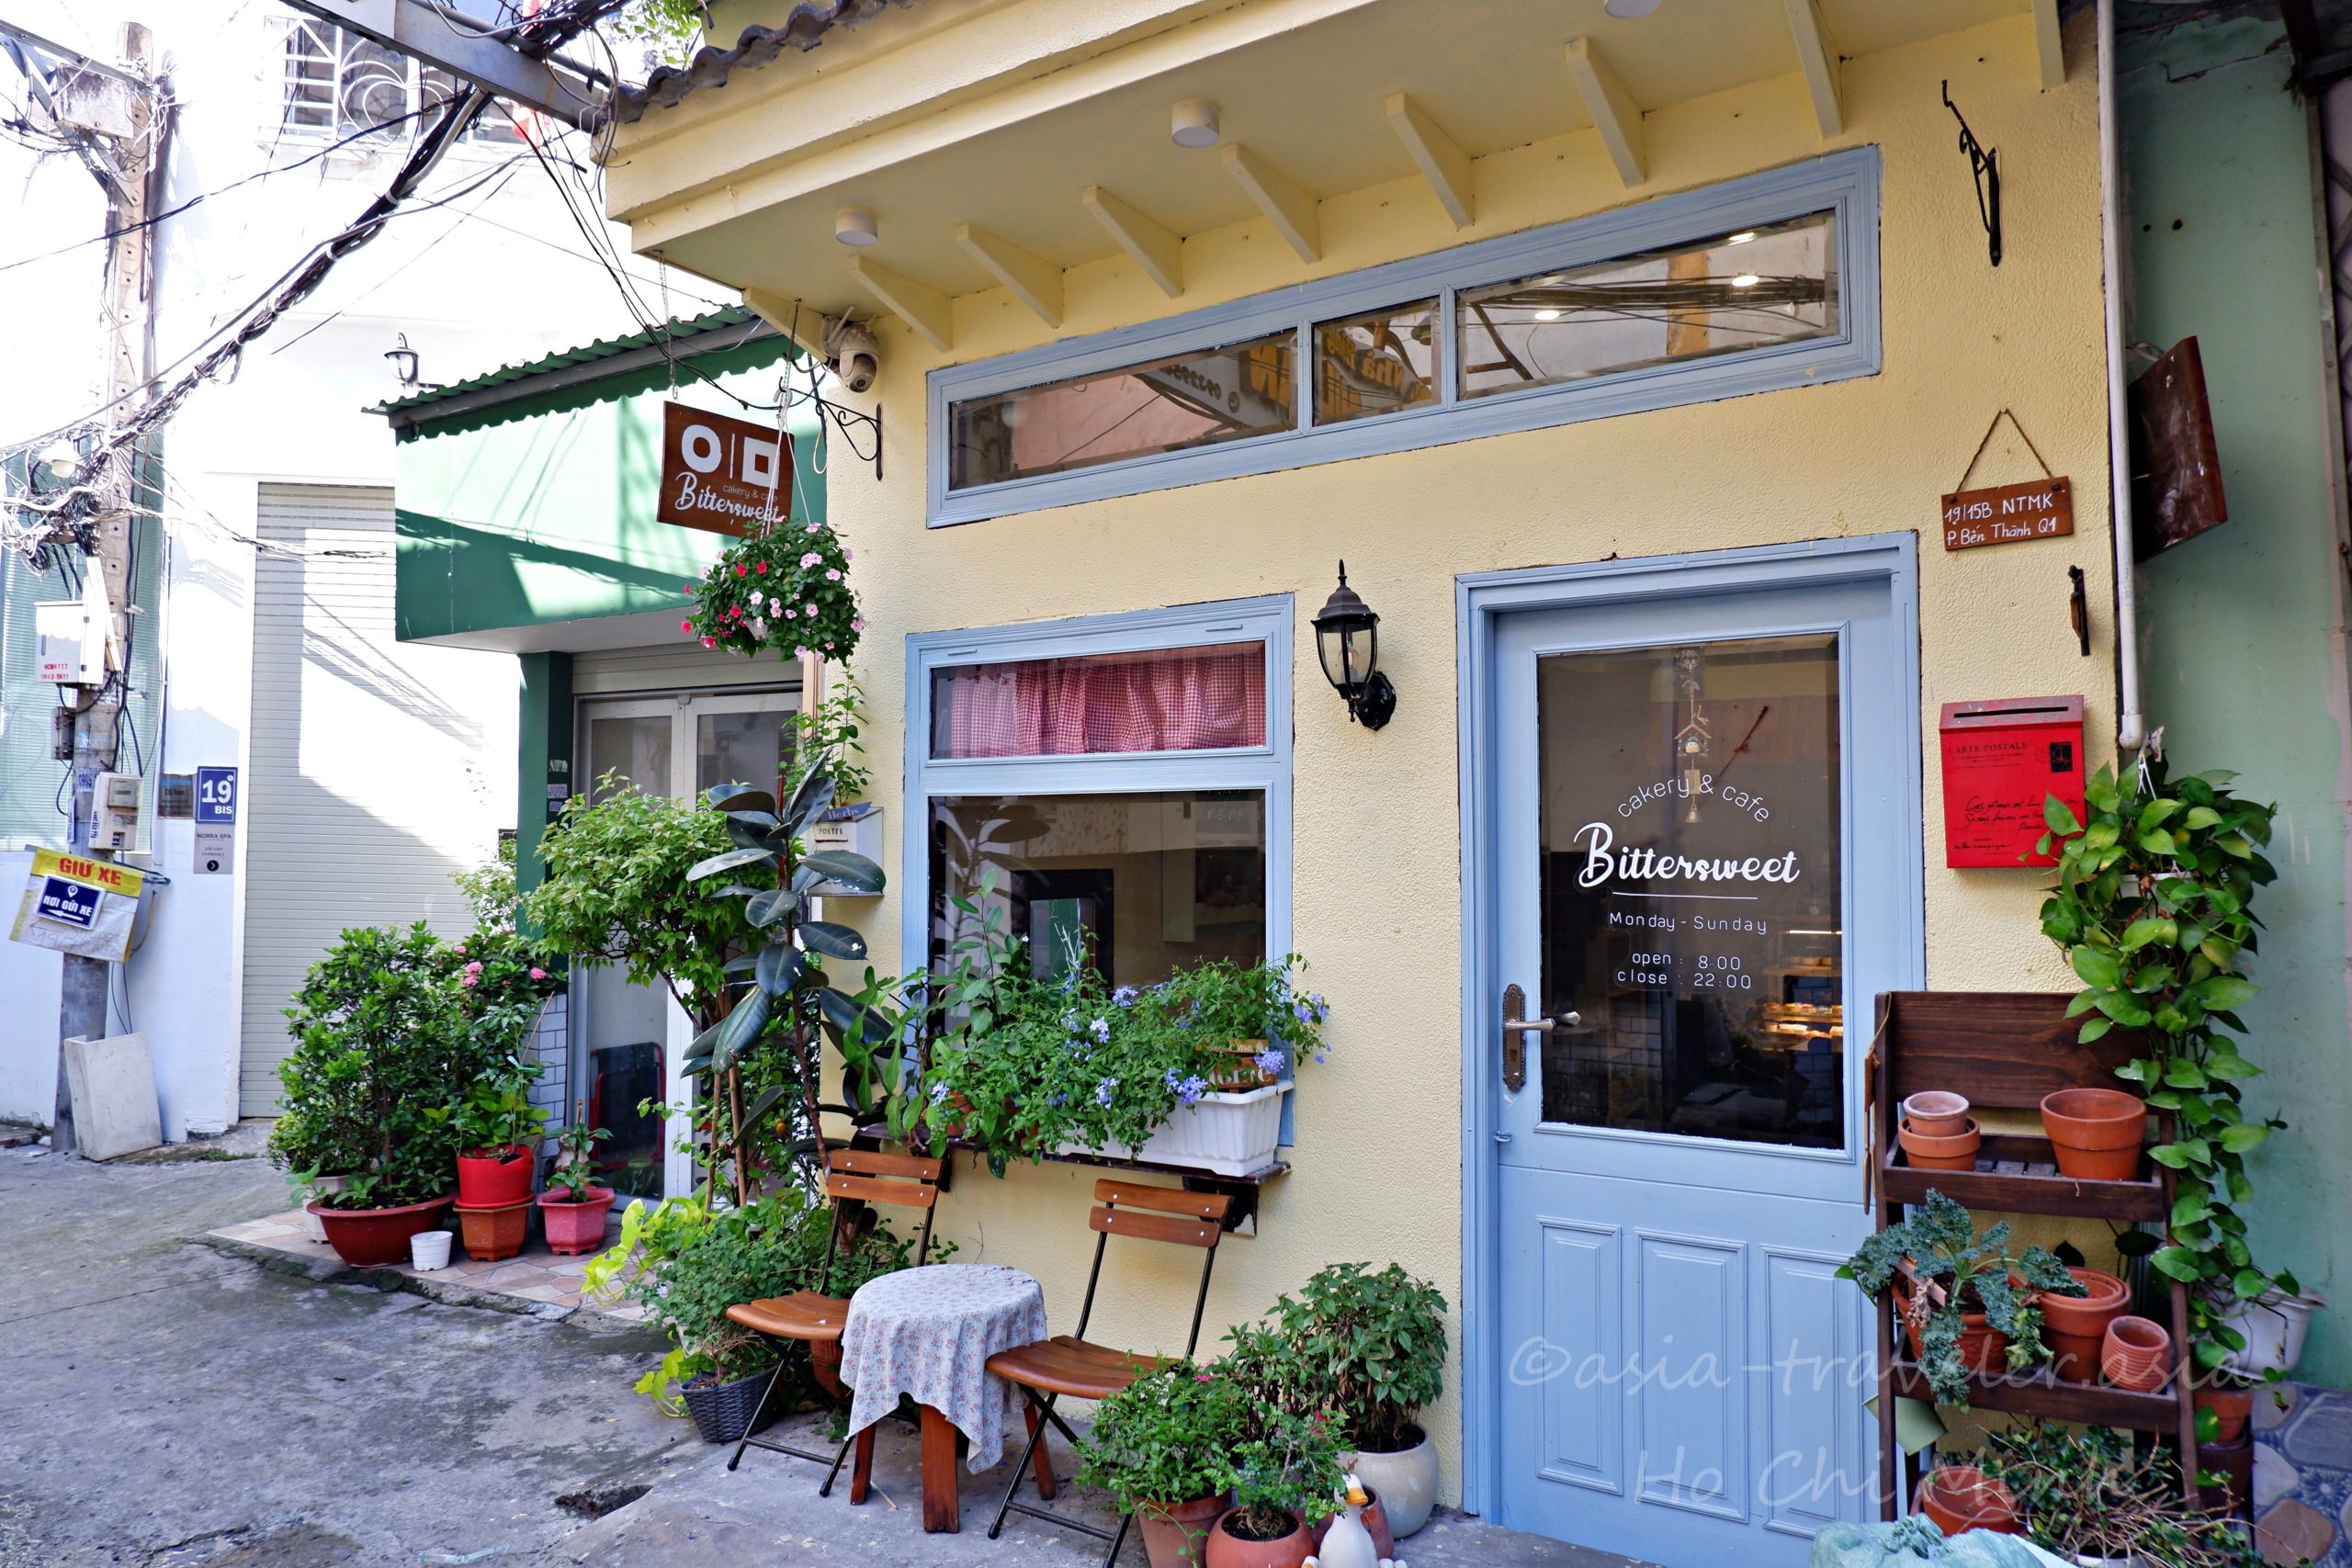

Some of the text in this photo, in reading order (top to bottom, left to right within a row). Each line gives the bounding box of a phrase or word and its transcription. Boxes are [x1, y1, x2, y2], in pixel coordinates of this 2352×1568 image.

[674, 471, 779, 523] Bittersweet
[723, 485, 751, 499] cakery
[752, 490, 758, 499] &
[2002, 492, 2053, 515] NTMK
[1984, 742, 2028, 751] POSTALE
[201, 779, 232, 804] 19
[1618, 774, 1770, 822] cakery & cafe
[214, 806, 233, 815] BIS
[828, 807, 860, 820] Herbs
[1573, 822, 1801, 887] Bittersweet
[59, 856, 122, 886] GIỮ XE
[42, 895, 61, 908] NƠI
[79, 905, 93, 917] XE
[1610, 912, 1676, 931] Monday
[1693, 916, 1768, 935] Sunday
[1632, 953, 1671, 967] open
[1617, 969, 1668, 985] close
[1694, 973, 1751, 989] 22:00
